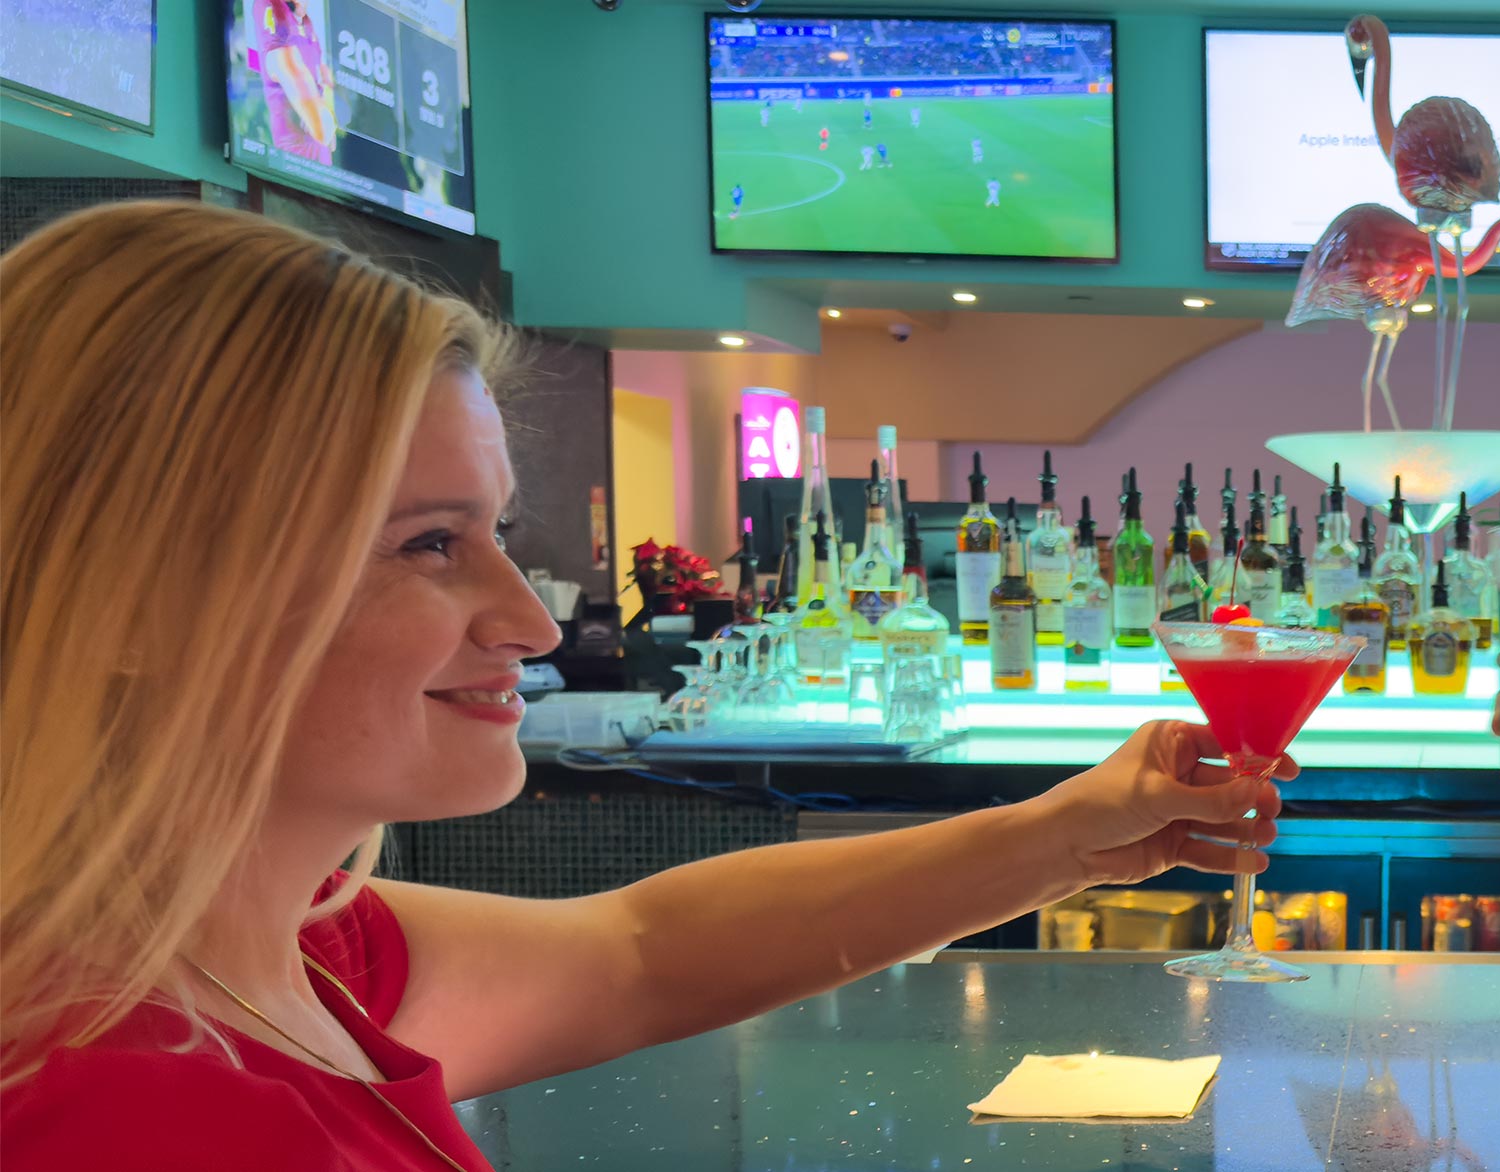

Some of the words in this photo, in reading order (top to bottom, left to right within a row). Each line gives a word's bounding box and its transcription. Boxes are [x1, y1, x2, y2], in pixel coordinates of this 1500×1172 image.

[338, 30, 390, 85] 208
[422, 70, 439, 106] 3
[1299, 133, 1340, 148] Apple
